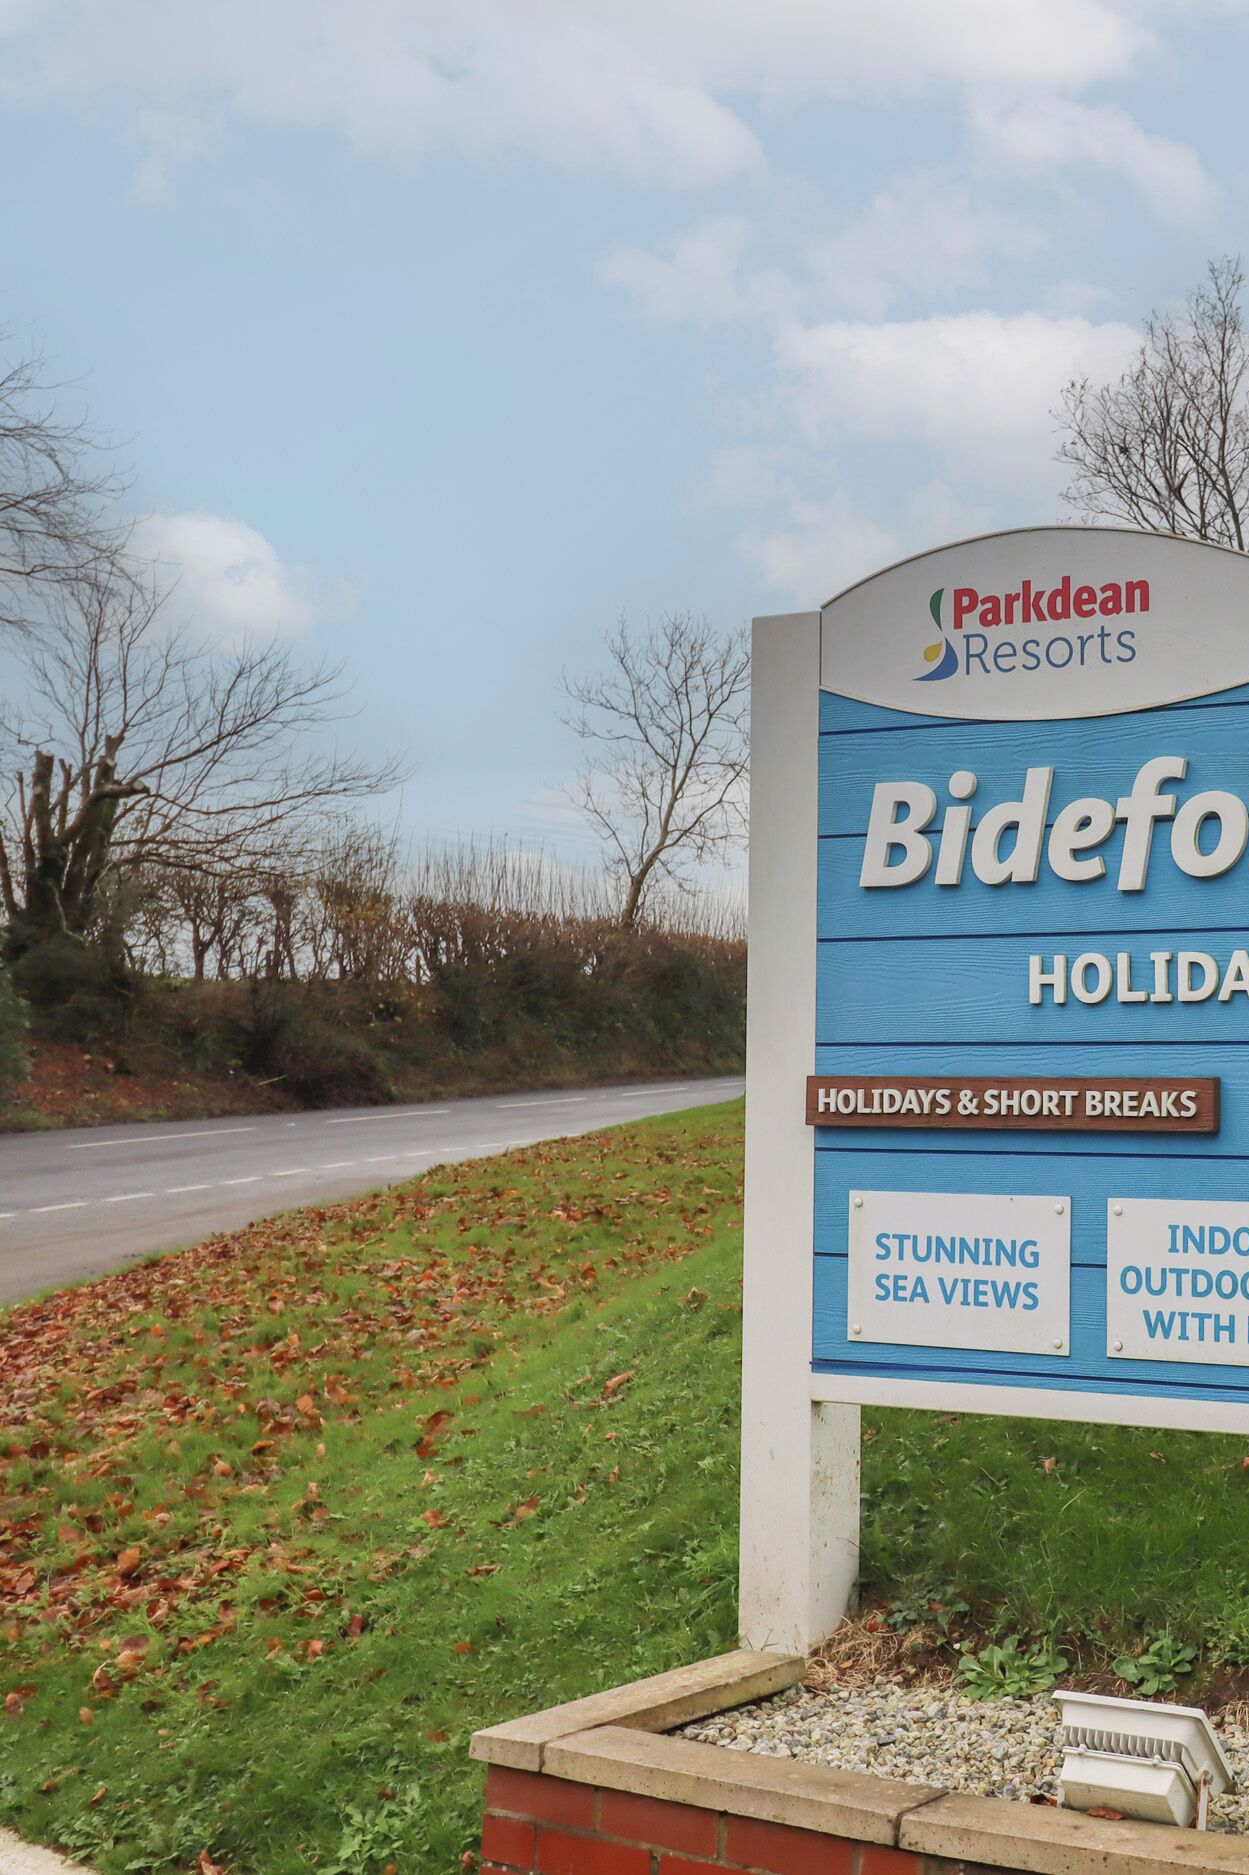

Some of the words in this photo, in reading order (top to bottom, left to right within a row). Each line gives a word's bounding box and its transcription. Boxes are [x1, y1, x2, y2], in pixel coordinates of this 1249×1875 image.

[953, 575, 1150, 629] Parkdean
[963, 625, 1136, 675] Resorts
[817, 1088, 951, 1115] HOLIDAYS
[957, 1089, 980, 1116] &
[984, 1089, 1079, 1117] SHORT
[1085, 1090, 1198, 1119] BREAKS
[875, 1233, 1040, 1268] STUNNING
[875, 1273, 930, 1303] SEA
[938, 1277, 1039, 1310] VIEWS
[1143, 1309, 1236, 1343] WITH
